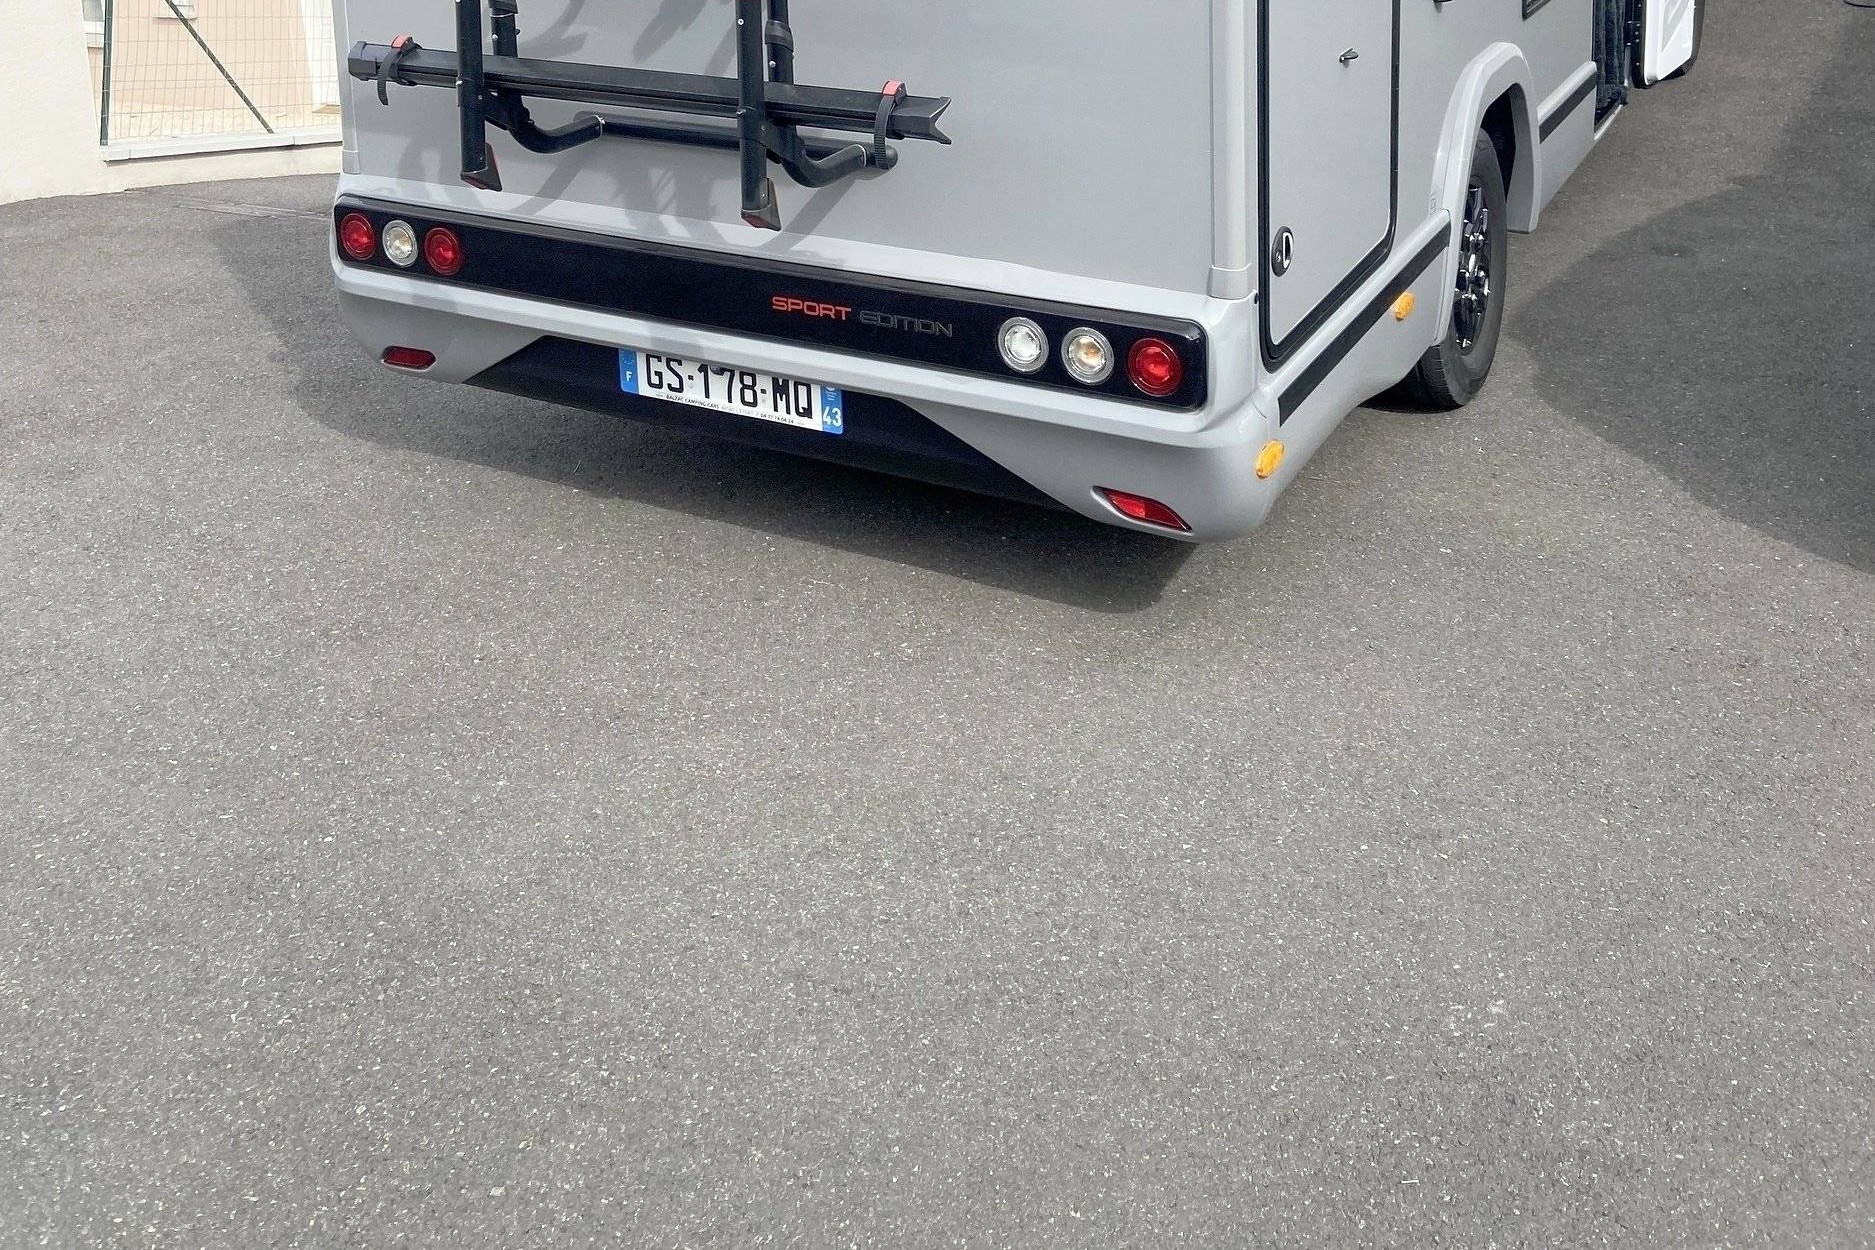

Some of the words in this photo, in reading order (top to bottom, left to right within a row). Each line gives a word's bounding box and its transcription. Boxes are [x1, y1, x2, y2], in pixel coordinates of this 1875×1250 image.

[772, 296, 851, 320] SPORT
[859, 310, 953, 337] EDITION
[626, 370, 633, 382] F
[646, 353, 813, 420] GS-178-MQ
[822, 405, 842, 427] 43
